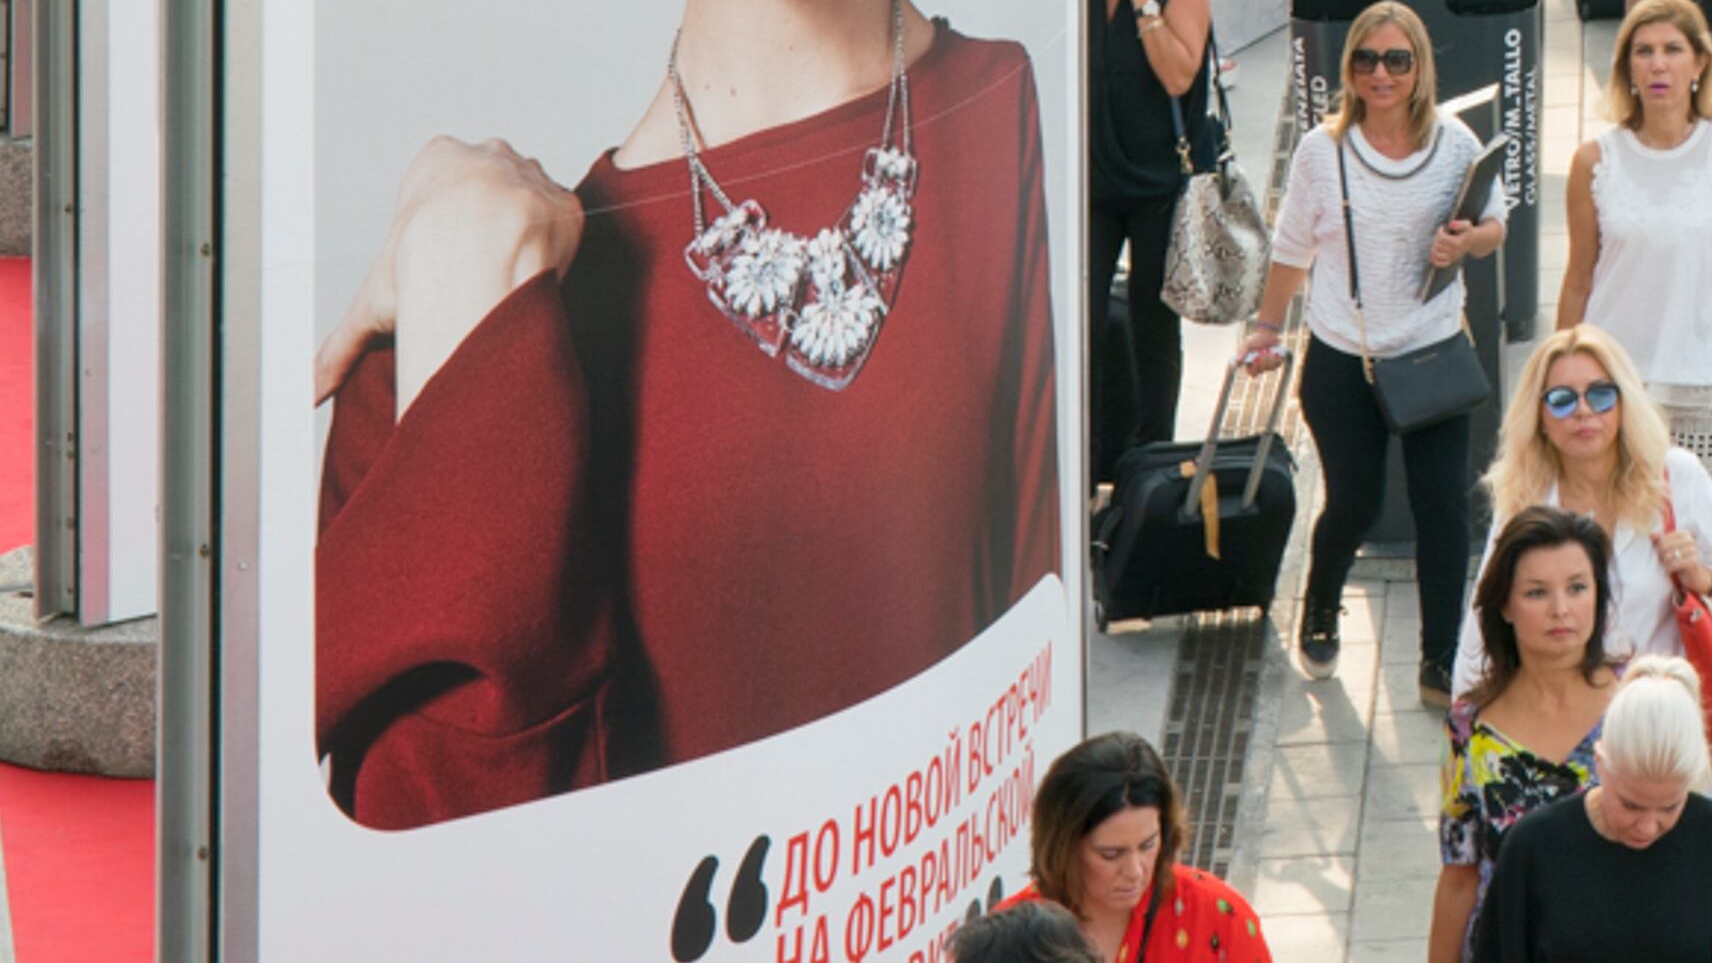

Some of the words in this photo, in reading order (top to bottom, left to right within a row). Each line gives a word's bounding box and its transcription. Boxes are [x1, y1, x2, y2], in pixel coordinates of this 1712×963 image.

[775, 818, 840, 927] ДО
[851, 724, 962, 876] НОВОЙ
[968, 639, 1053, 796] ВСТРЕЧИ
[845, 739, 1036, 963] ФЕВРАЛЬСКОЙ
